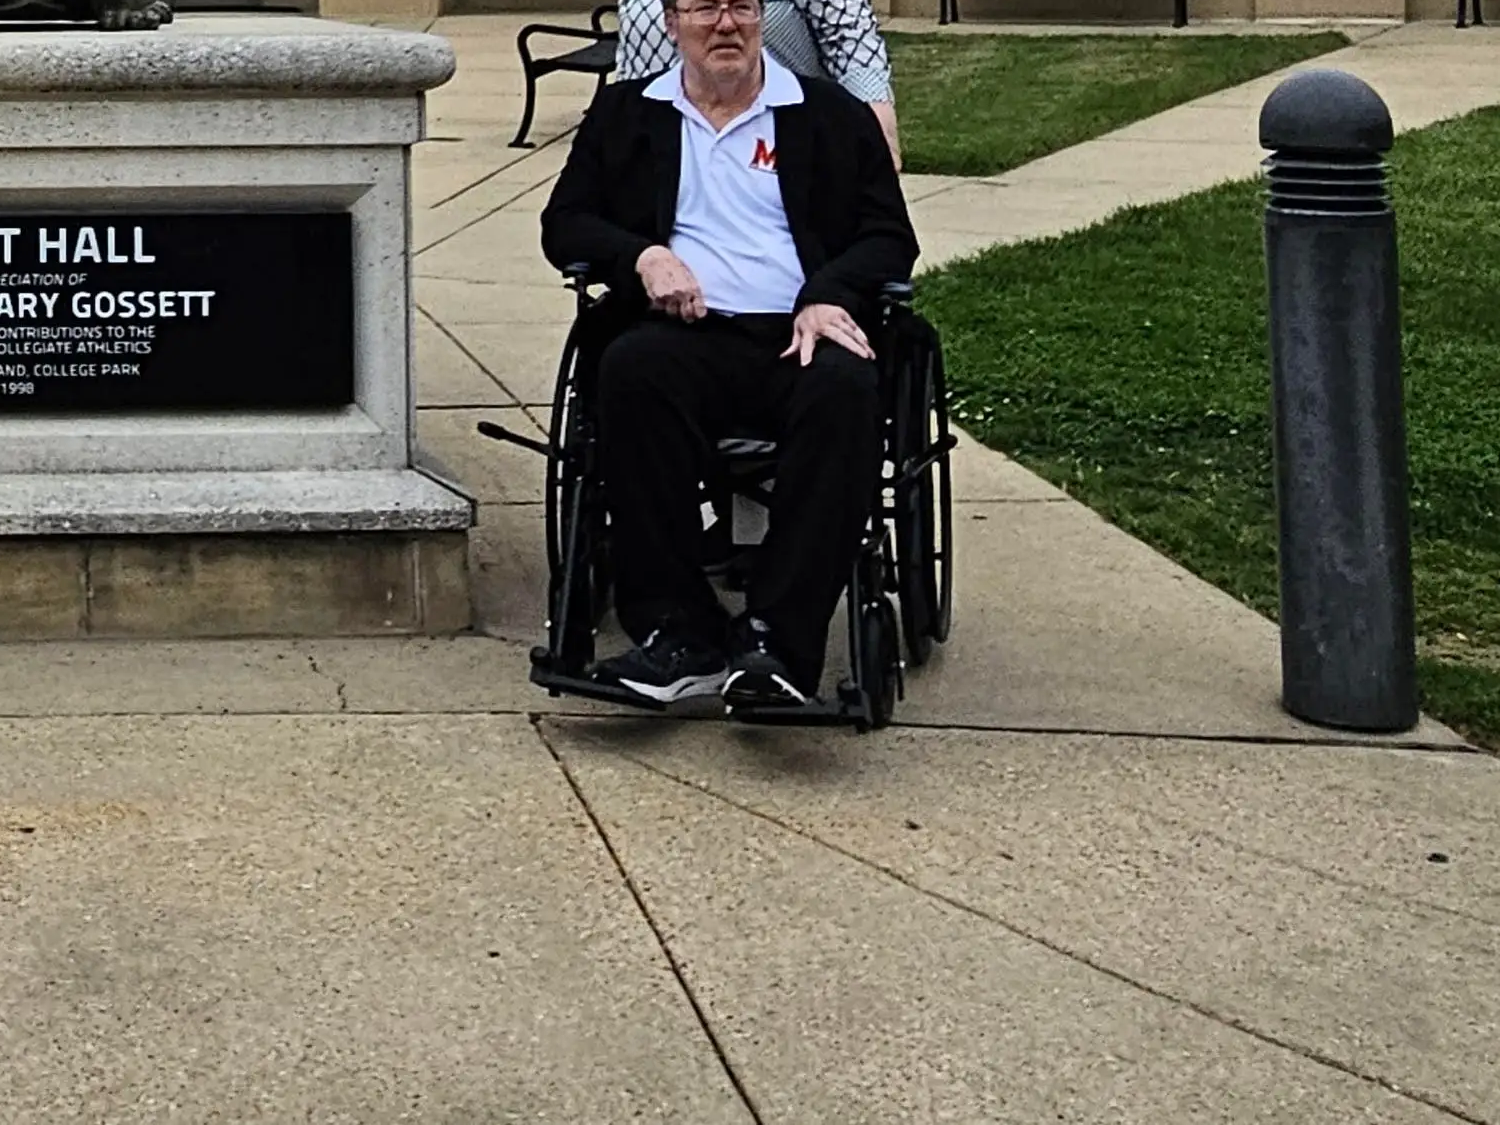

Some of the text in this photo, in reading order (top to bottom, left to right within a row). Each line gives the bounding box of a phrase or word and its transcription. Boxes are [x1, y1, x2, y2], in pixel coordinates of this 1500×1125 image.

[38, 226, 156, 264] HALL
[68, 273, 88, 286] OF
[71, 290, 216, 319] GOSSETT
[106, 325, 125, 339] TO
[128, 325, 156, 338] THE
[76, 341, 152, 354] ATHLETICS
[33, 363, 97, 377] COLLEGE
[101, 363, 140, 375] PARK
[0, 381, 35, 395] 1998
